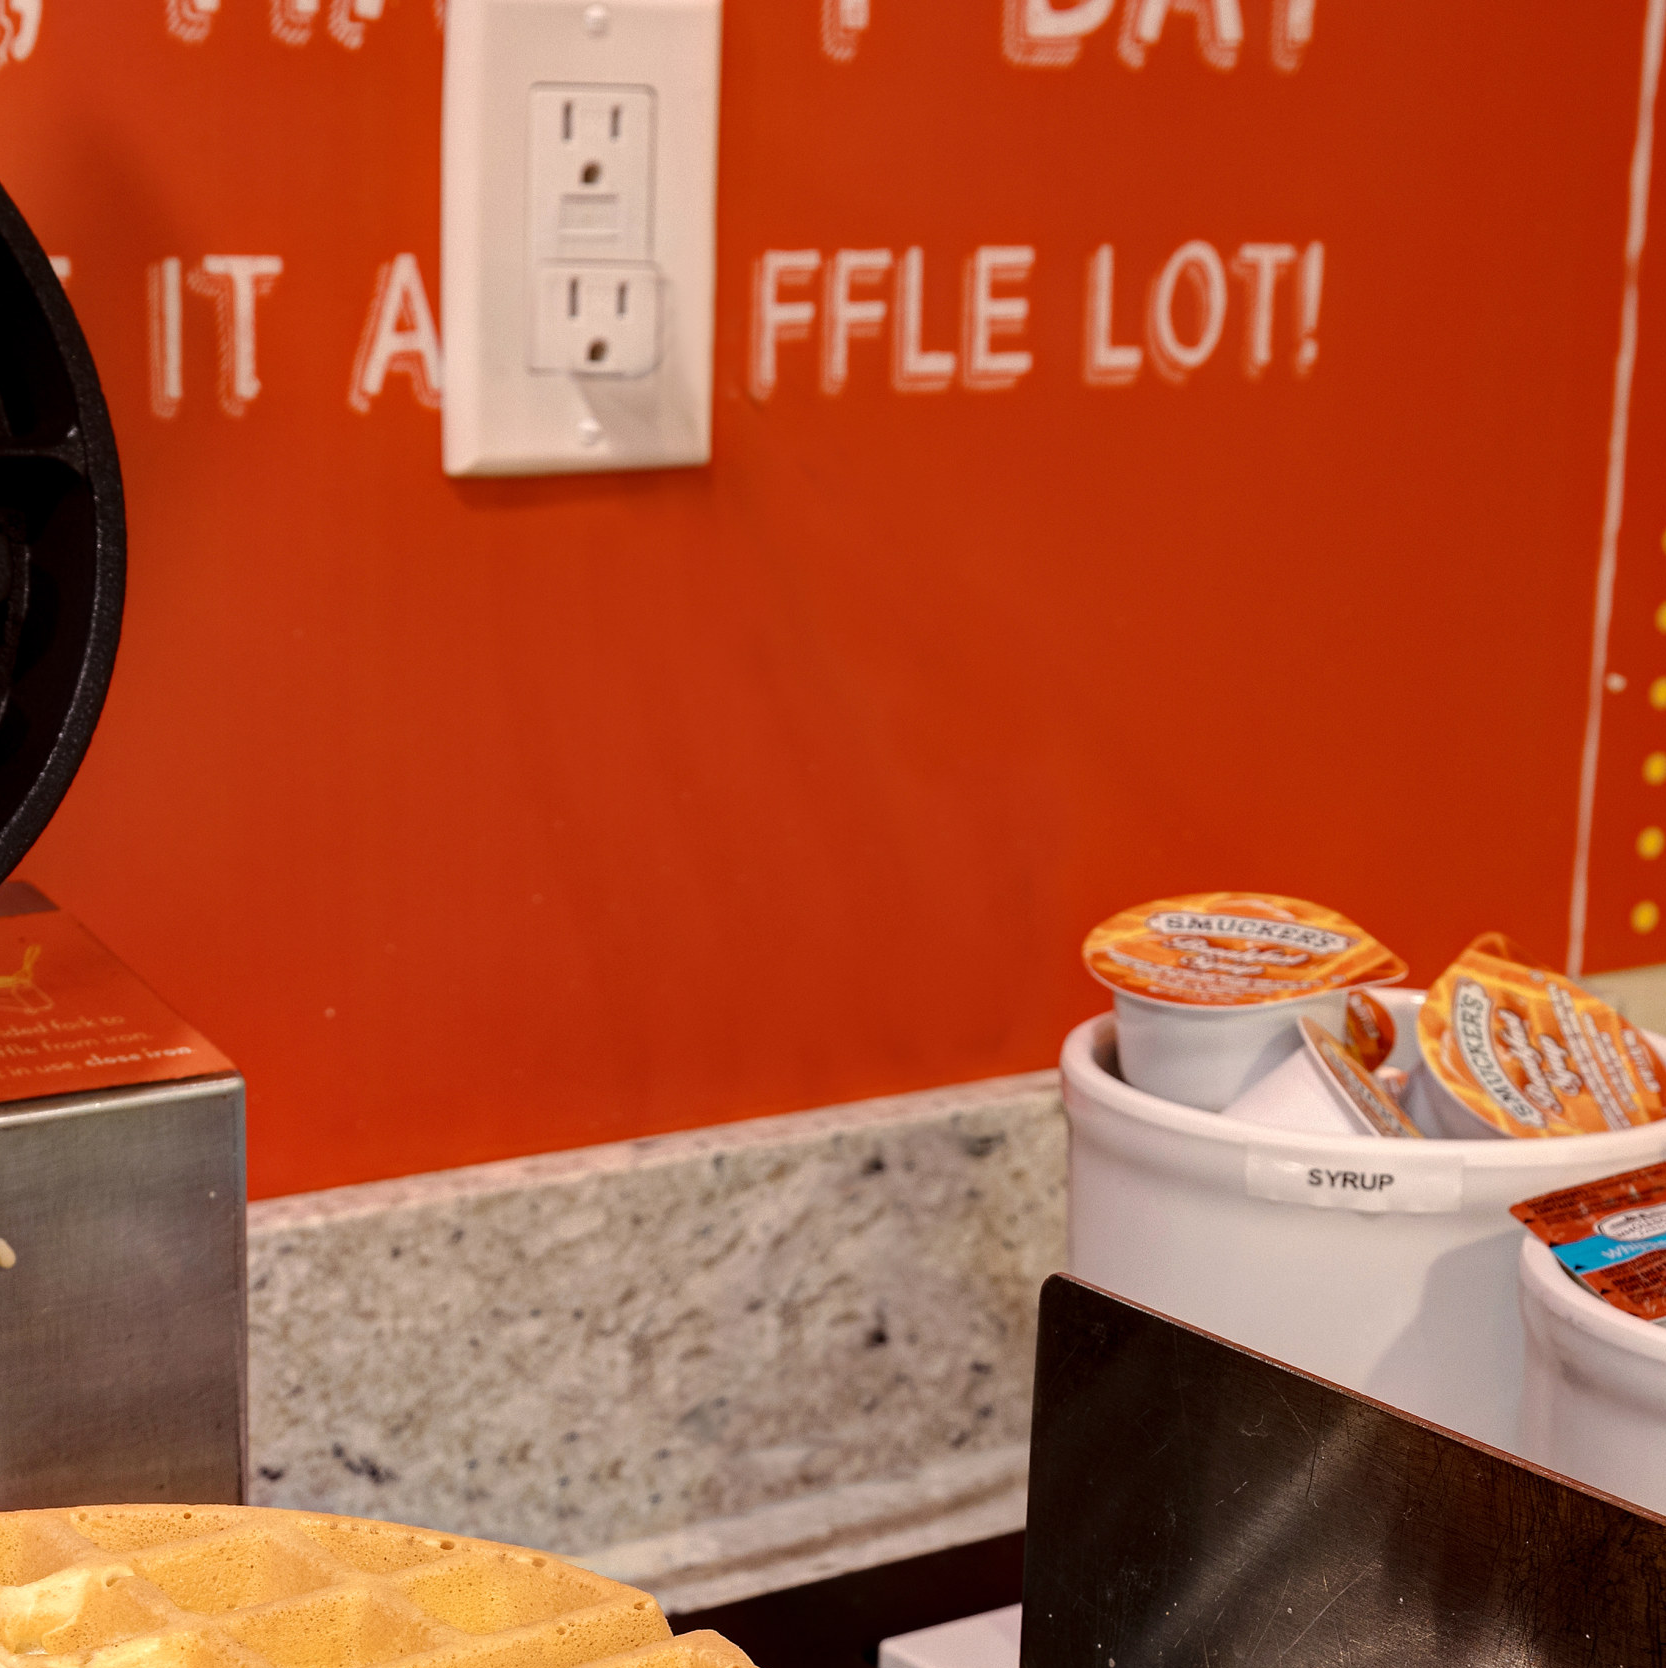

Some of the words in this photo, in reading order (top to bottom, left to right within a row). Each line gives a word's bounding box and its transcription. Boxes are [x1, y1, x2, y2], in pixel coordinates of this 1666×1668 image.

[148, 255, 283, 417] IT
[750, 245, 1036, 400] FFLE
[1084, 239, 1324, 387] LOT!
[1307, 1167, 1396, 1193] SYRUP
